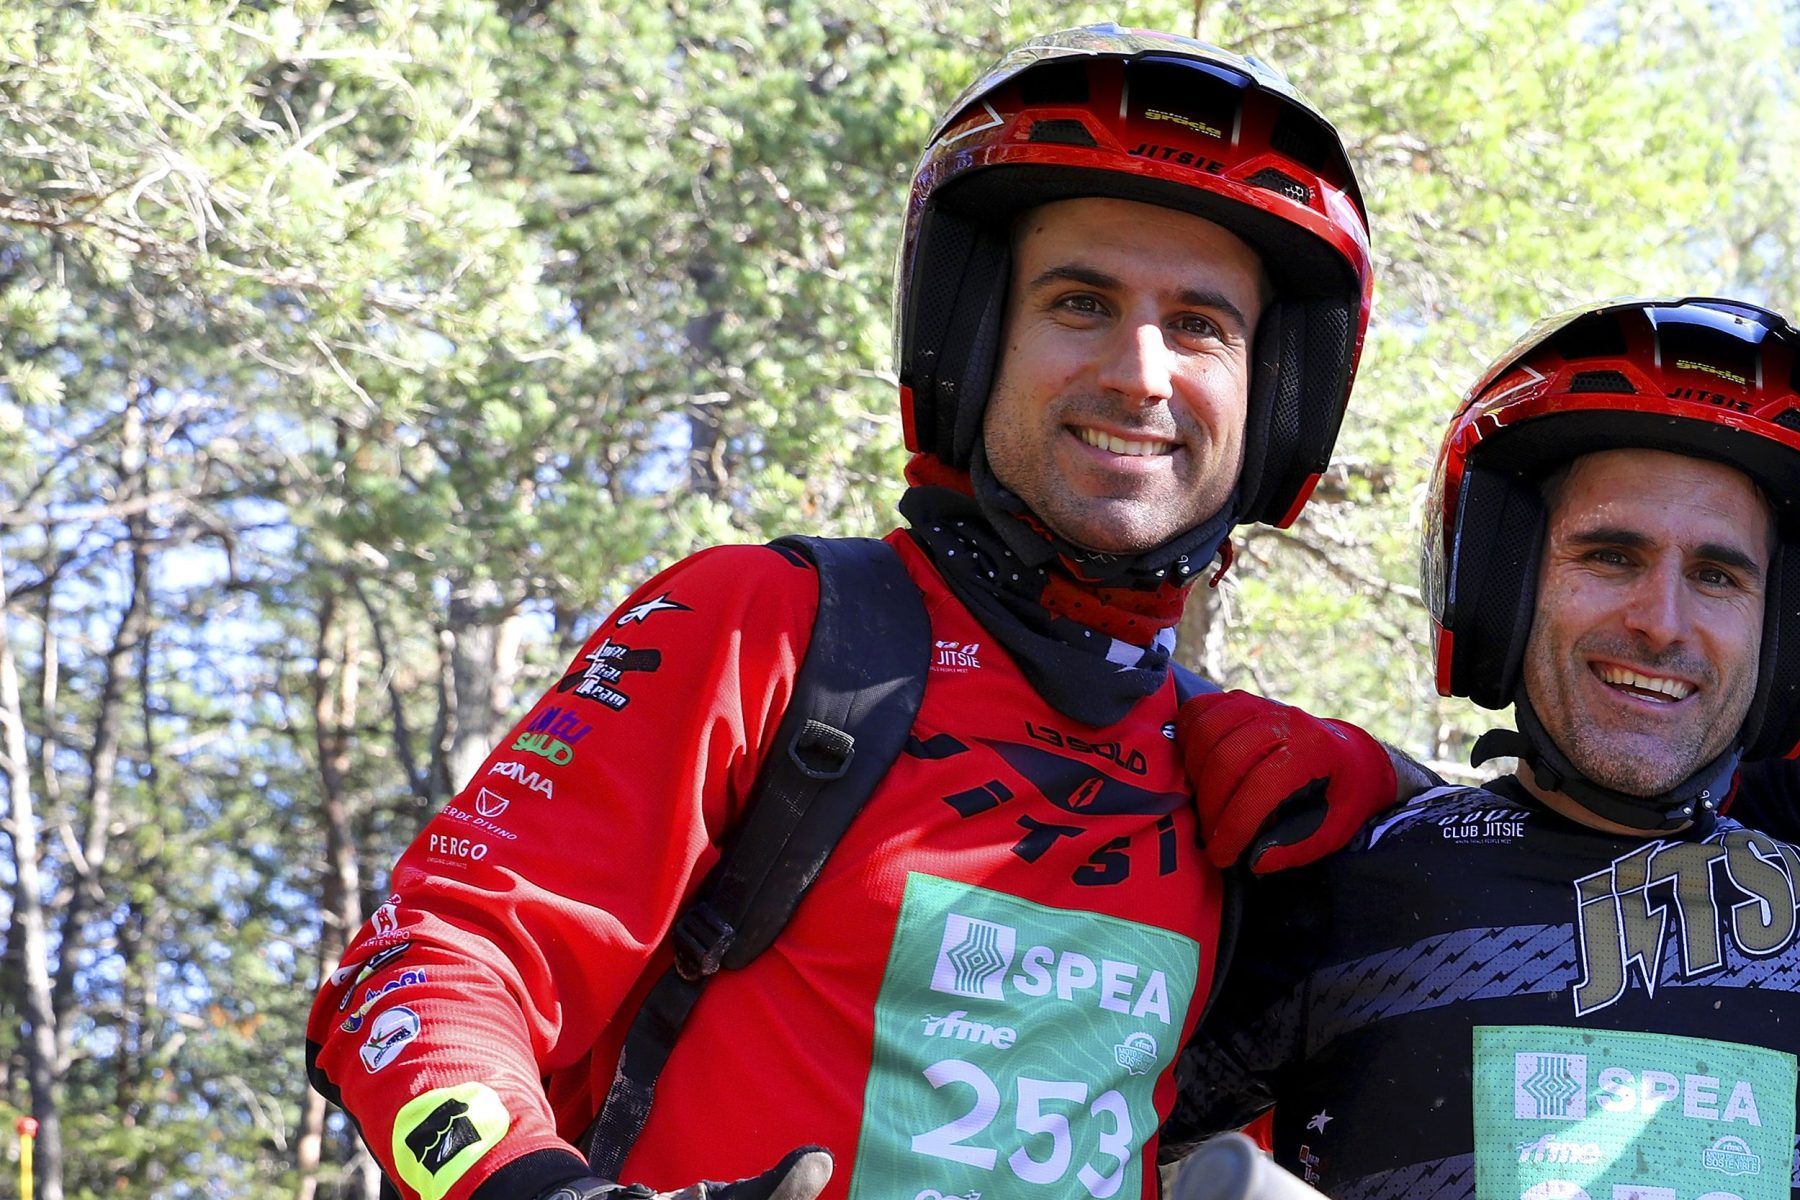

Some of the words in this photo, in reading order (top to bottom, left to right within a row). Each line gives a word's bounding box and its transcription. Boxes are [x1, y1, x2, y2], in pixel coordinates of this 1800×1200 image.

[1127, 143, 1226, 174] JITSIE
[1665, 387, 1754, 412] JITSIE
[937, 650, 981, 668] JITSIE
[487, 761, 554, 800] POMA
[439, 806, 473, 822] ERDE
[472, 817, 519, 841] DIVINO
[1442, 825, 1479, 839] CLUB
[1482, 822, 1525, 837] JITSIE
[429, 833, 488, 861] PERGO
[1011, 944, 1172, 1026] SPEA
[921, 1009, 1018, 1050] rfme
[1595, 1066, 1763, 1128] SPEA
[910, 1058, 1134, 1200] 253
